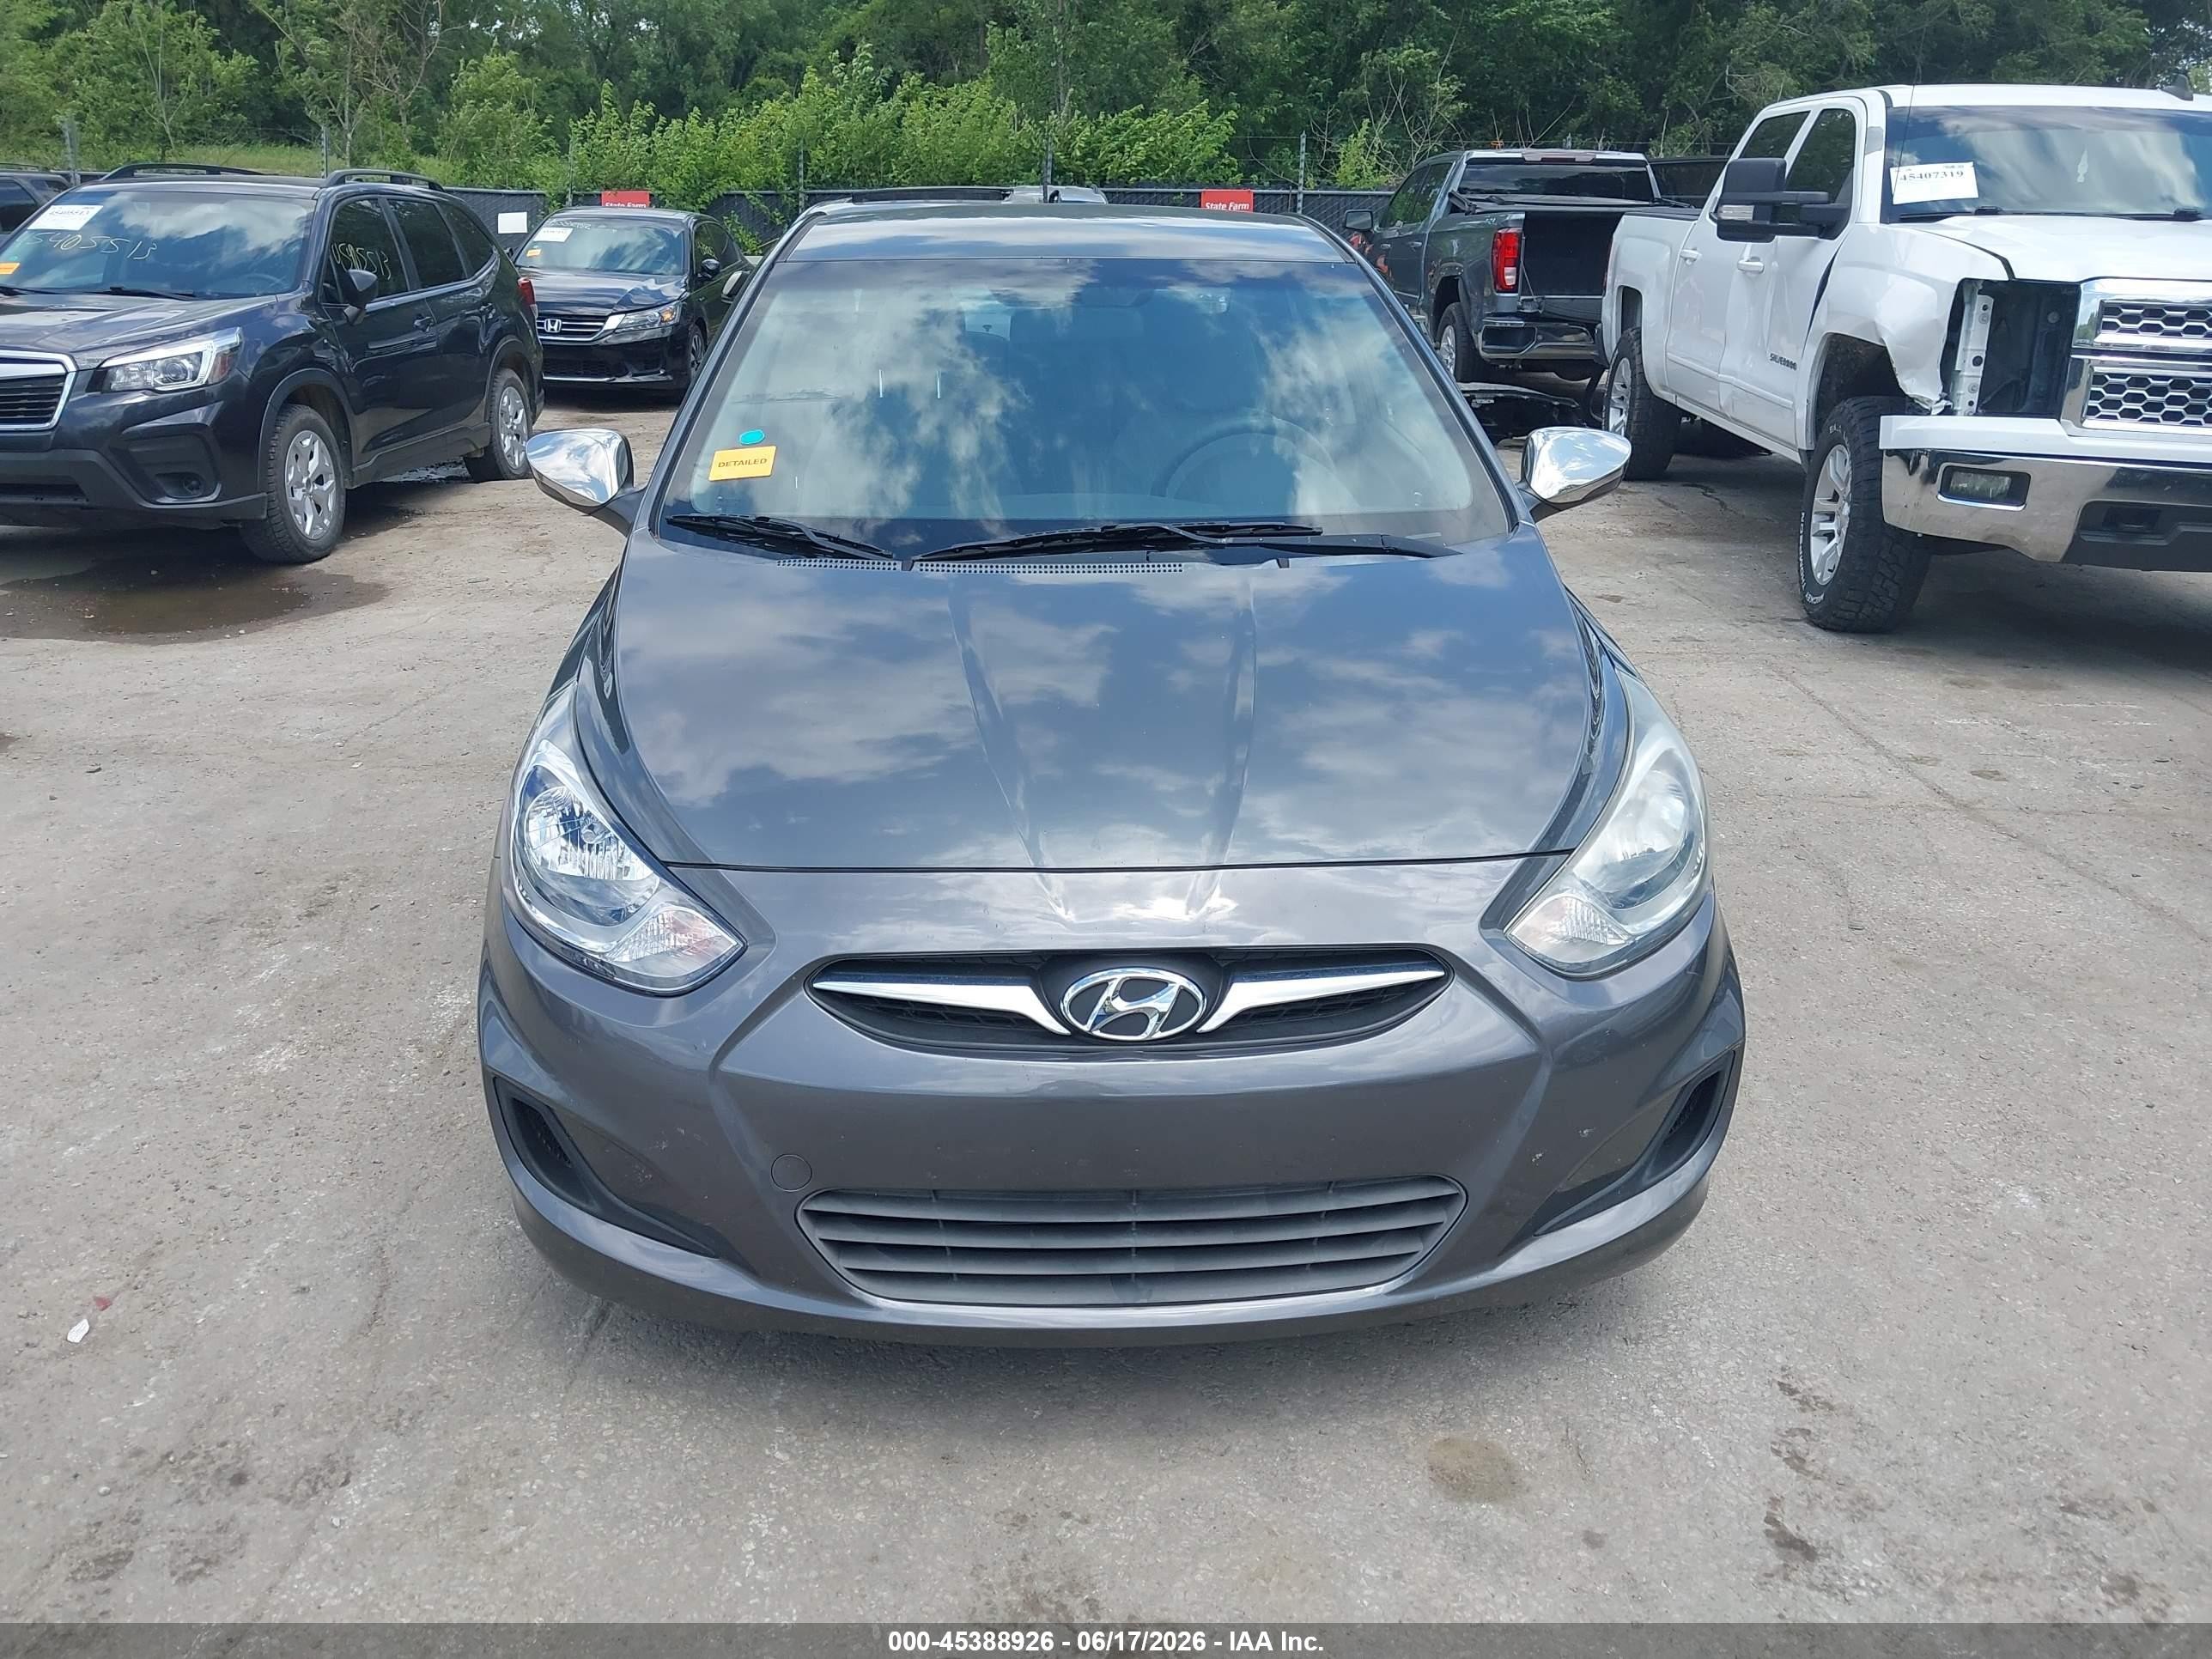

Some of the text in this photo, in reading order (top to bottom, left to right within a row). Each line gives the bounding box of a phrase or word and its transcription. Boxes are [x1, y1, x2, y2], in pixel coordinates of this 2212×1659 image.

[1899, 170, 1965, 181] 45407319
[1205, 201, 1249, 211] State Farm
[718, 458, 768, 467] DETAILED
